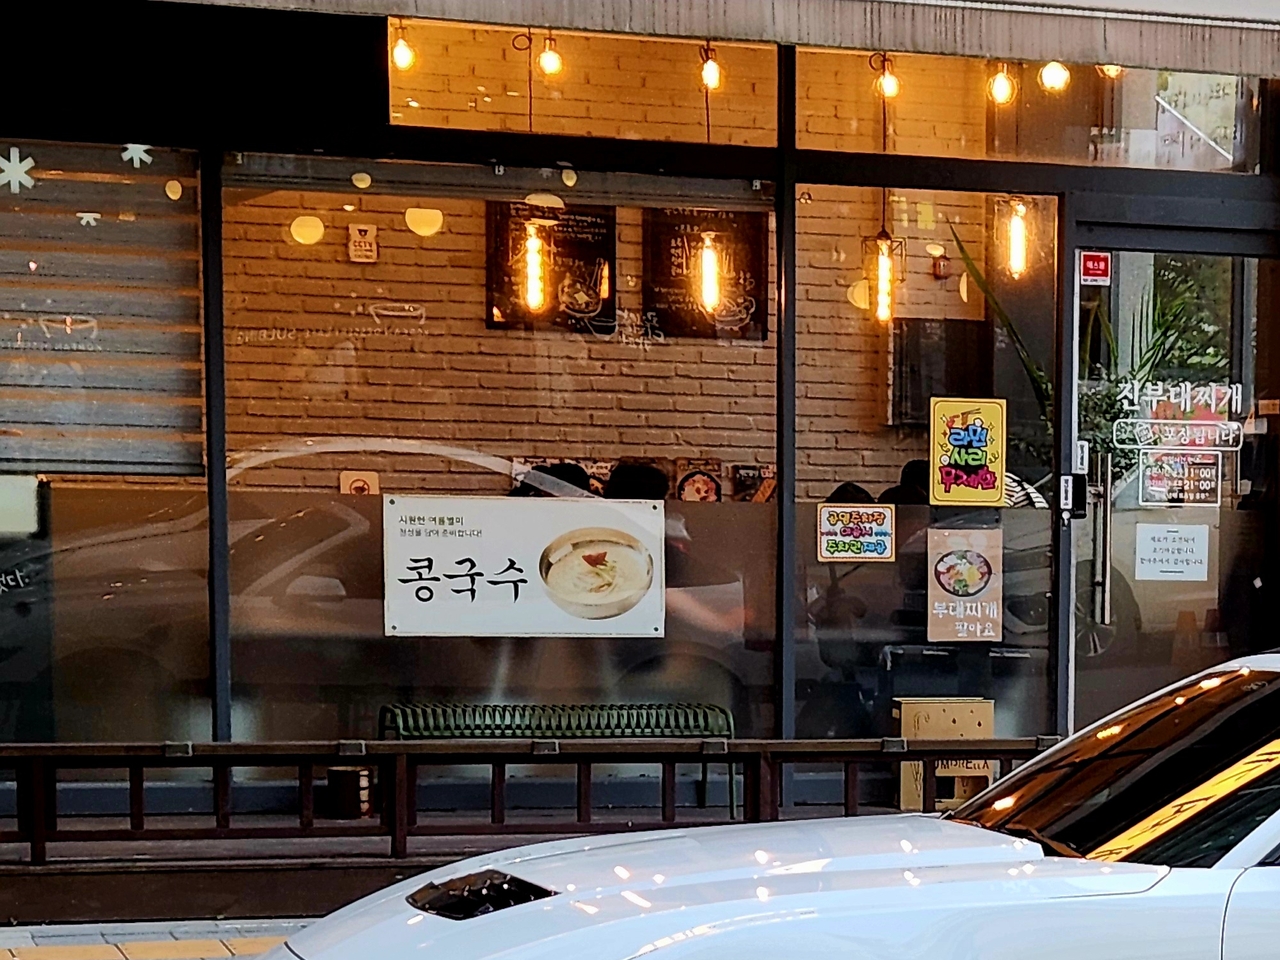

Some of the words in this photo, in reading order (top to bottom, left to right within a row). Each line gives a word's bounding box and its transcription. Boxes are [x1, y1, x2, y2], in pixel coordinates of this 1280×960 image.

[1115, 380, 1243, 414] 진부대찌개
[948, 424, 988, 447] 라면
[949, 446, 987, 466] 사리
[939, 465, 997, 493] 무제한
[397, 557, 528, 604] 콩국수
[932, 601, 997, 618] 부대찌개
[955, 622, 996, 637] 팔아요
